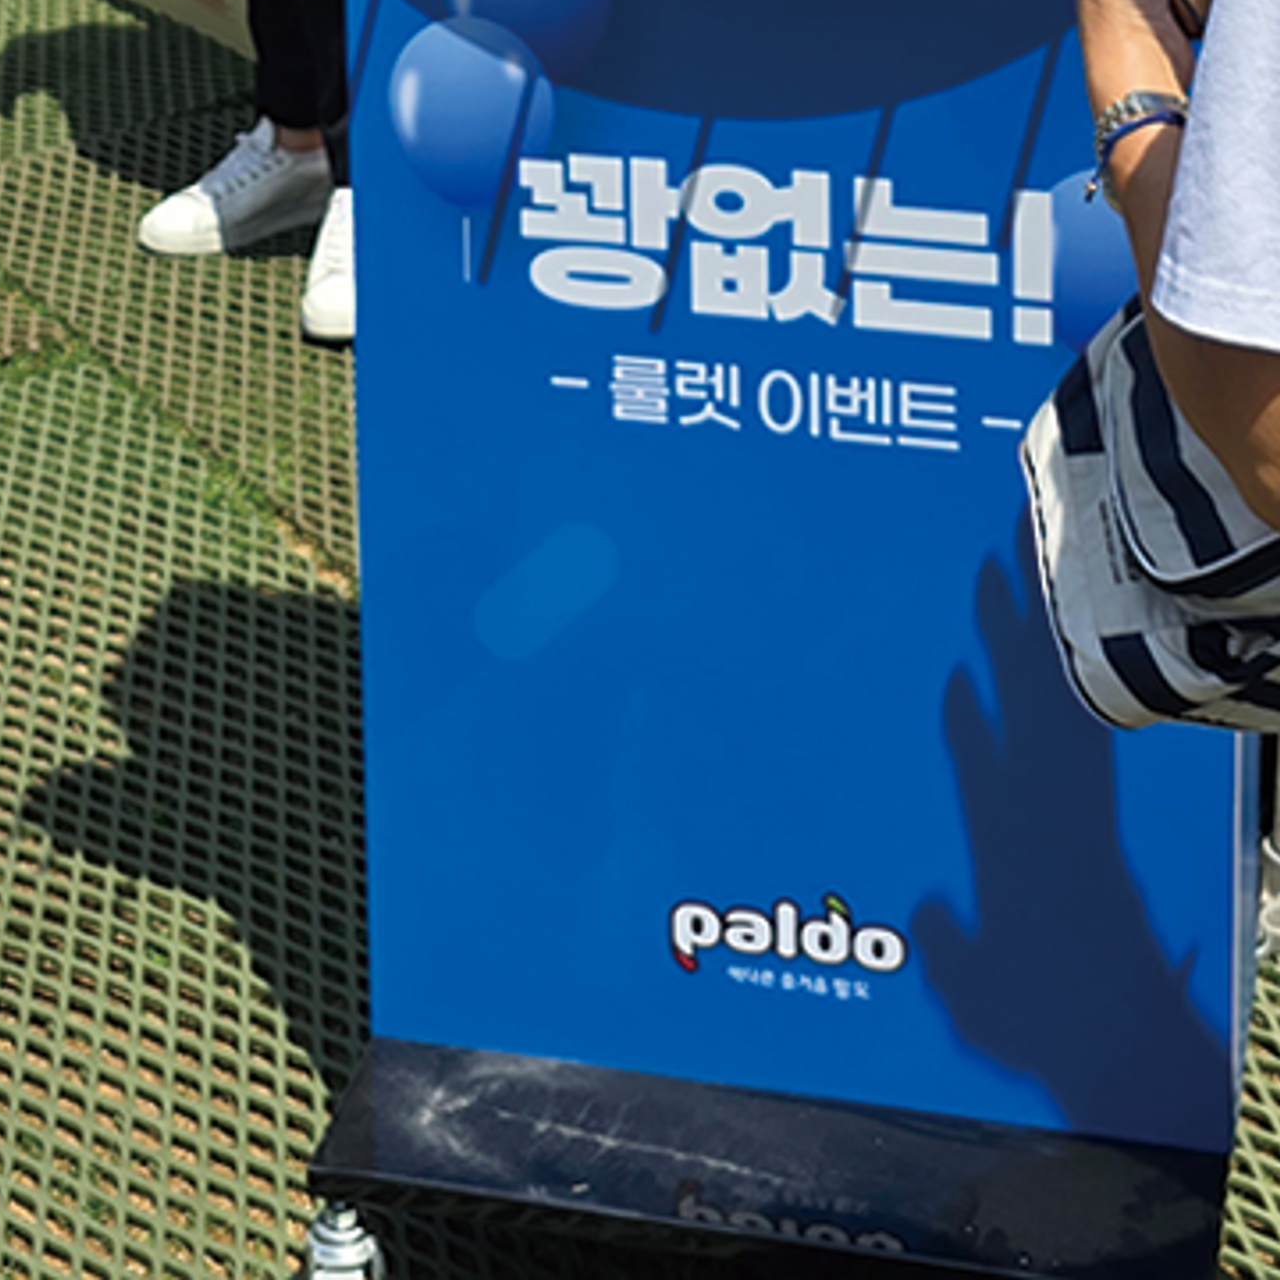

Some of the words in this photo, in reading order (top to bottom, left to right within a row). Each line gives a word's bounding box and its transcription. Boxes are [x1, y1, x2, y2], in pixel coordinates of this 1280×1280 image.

[519, 153, 1055, 346] 꽝없는!
[609, 353, 742, 431] 룰렛
[758, 367, 961, 451] 이벤트
[669, 892, 909, 974] paldo
